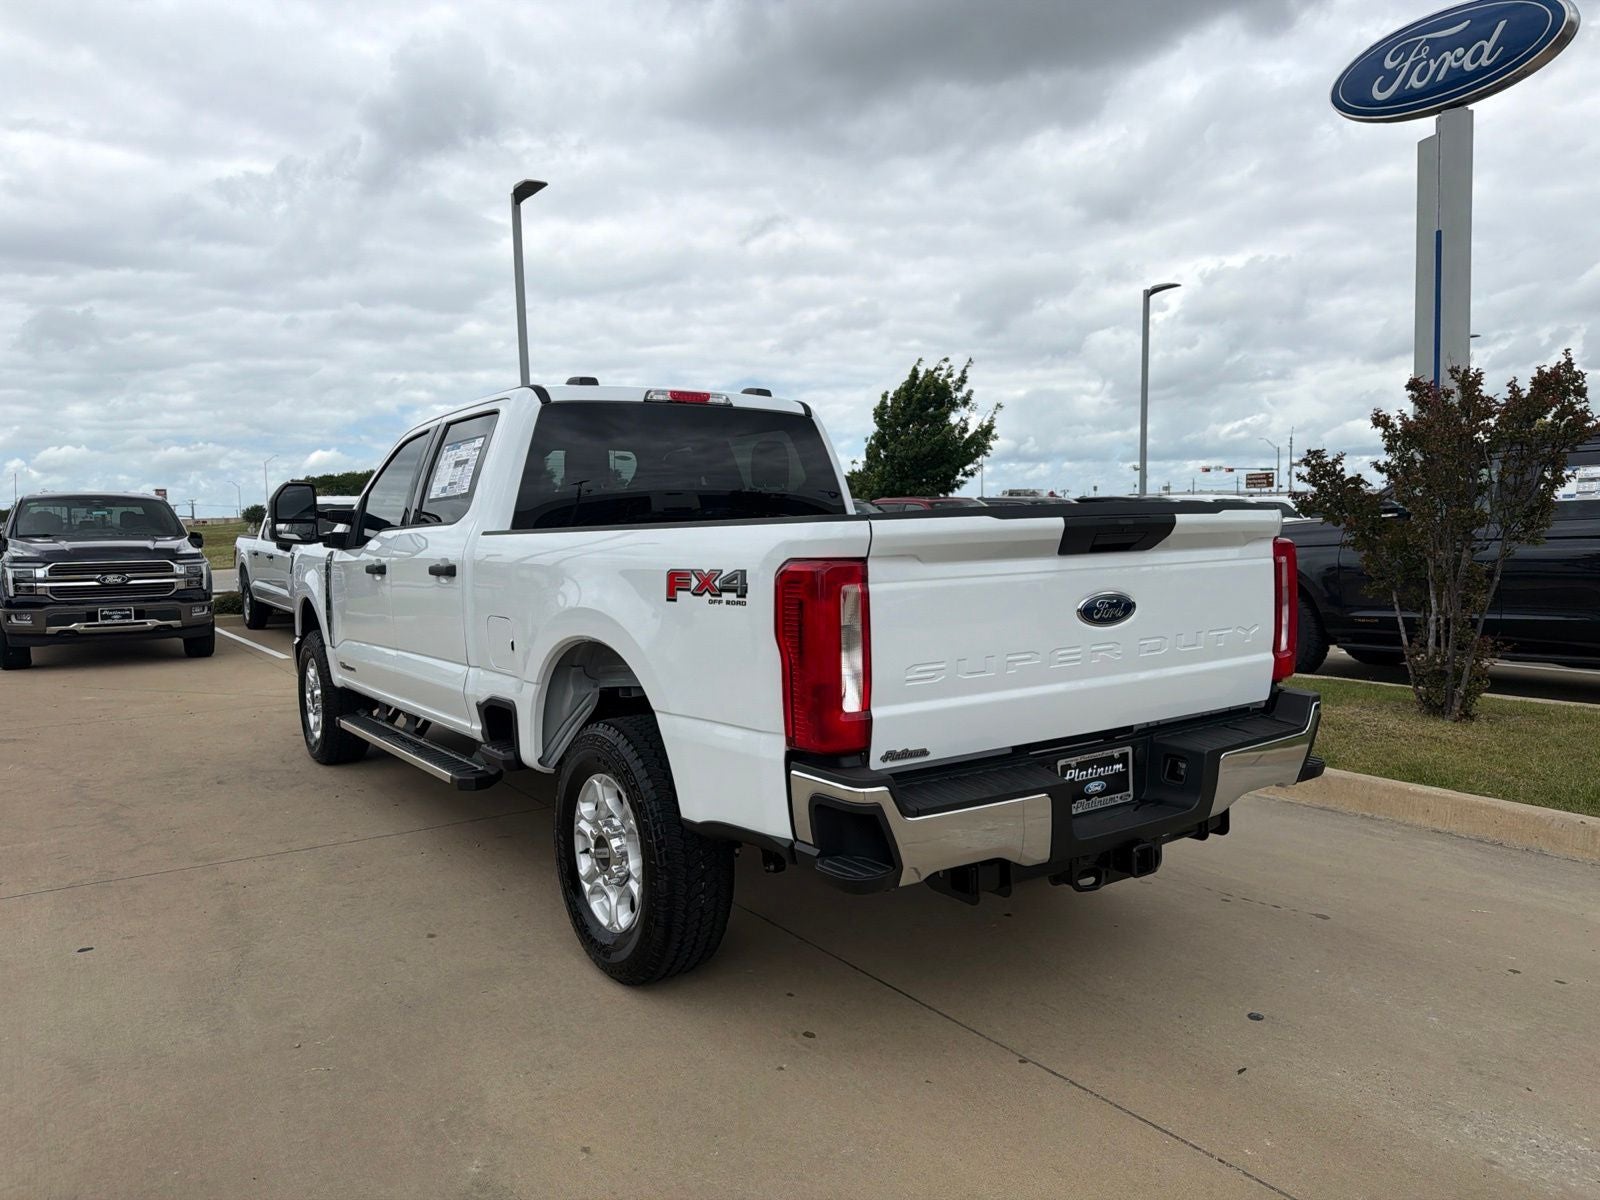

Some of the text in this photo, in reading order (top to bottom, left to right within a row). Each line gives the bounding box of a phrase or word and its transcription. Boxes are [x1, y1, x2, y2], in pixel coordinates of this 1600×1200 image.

[1372, 19, 1508, 101] Ford
[105, 575, 123, 585] Ford
[665, 568, 748, 602] FX4
[1093, 599, 1125, 619] Ford
[905, 623, 1260, 687] SUPER DUTY
[880, 747, 931, 763] Platinum
[1064, 762, 1127, 782] Platinum
[1086, 783, 1104, 794] Ford
[1075, 794, 1119, 812] Platinum
